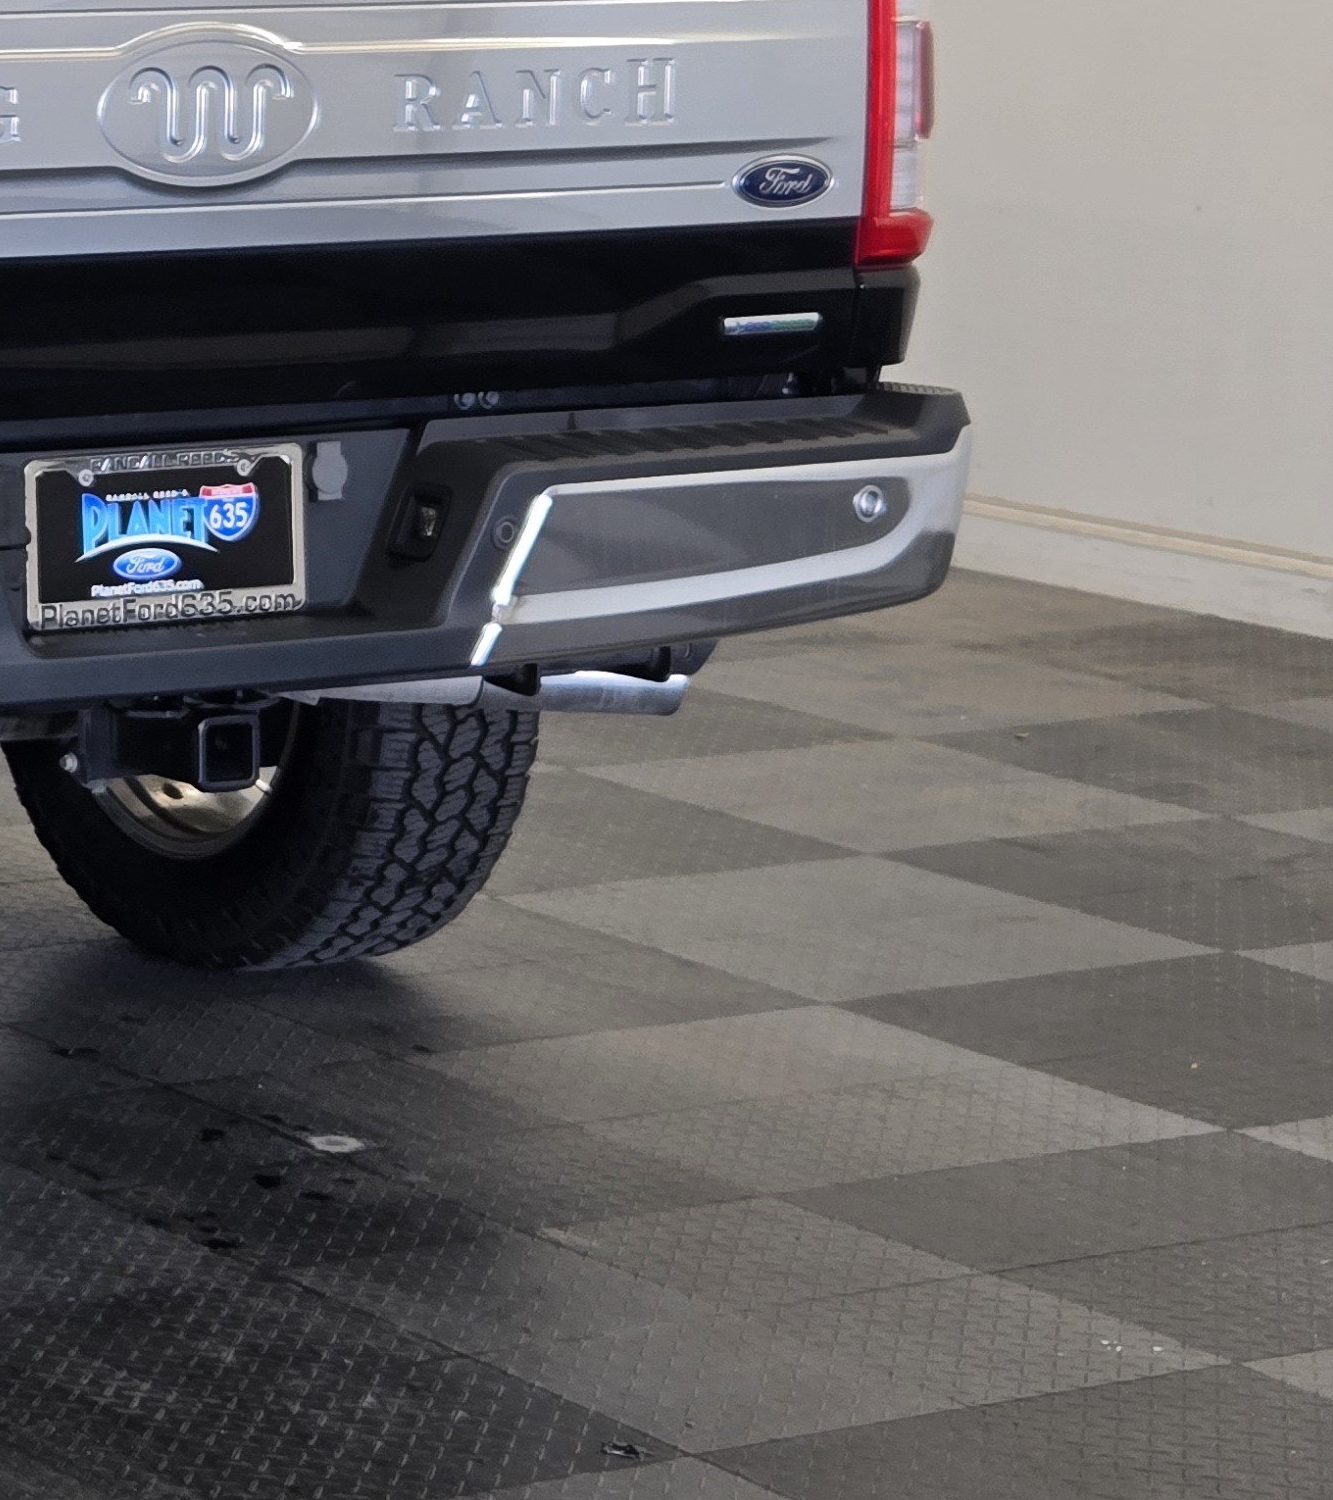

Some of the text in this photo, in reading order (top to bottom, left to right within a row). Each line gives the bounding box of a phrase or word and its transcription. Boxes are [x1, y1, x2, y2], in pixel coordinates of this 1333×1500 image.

[392, 57, 678, 132] RANCH
[82, 493, 209, 556] PLANET
[209, 501, 248, 529] 635
[39, 588, 299, 630] PlanetFord635.com
